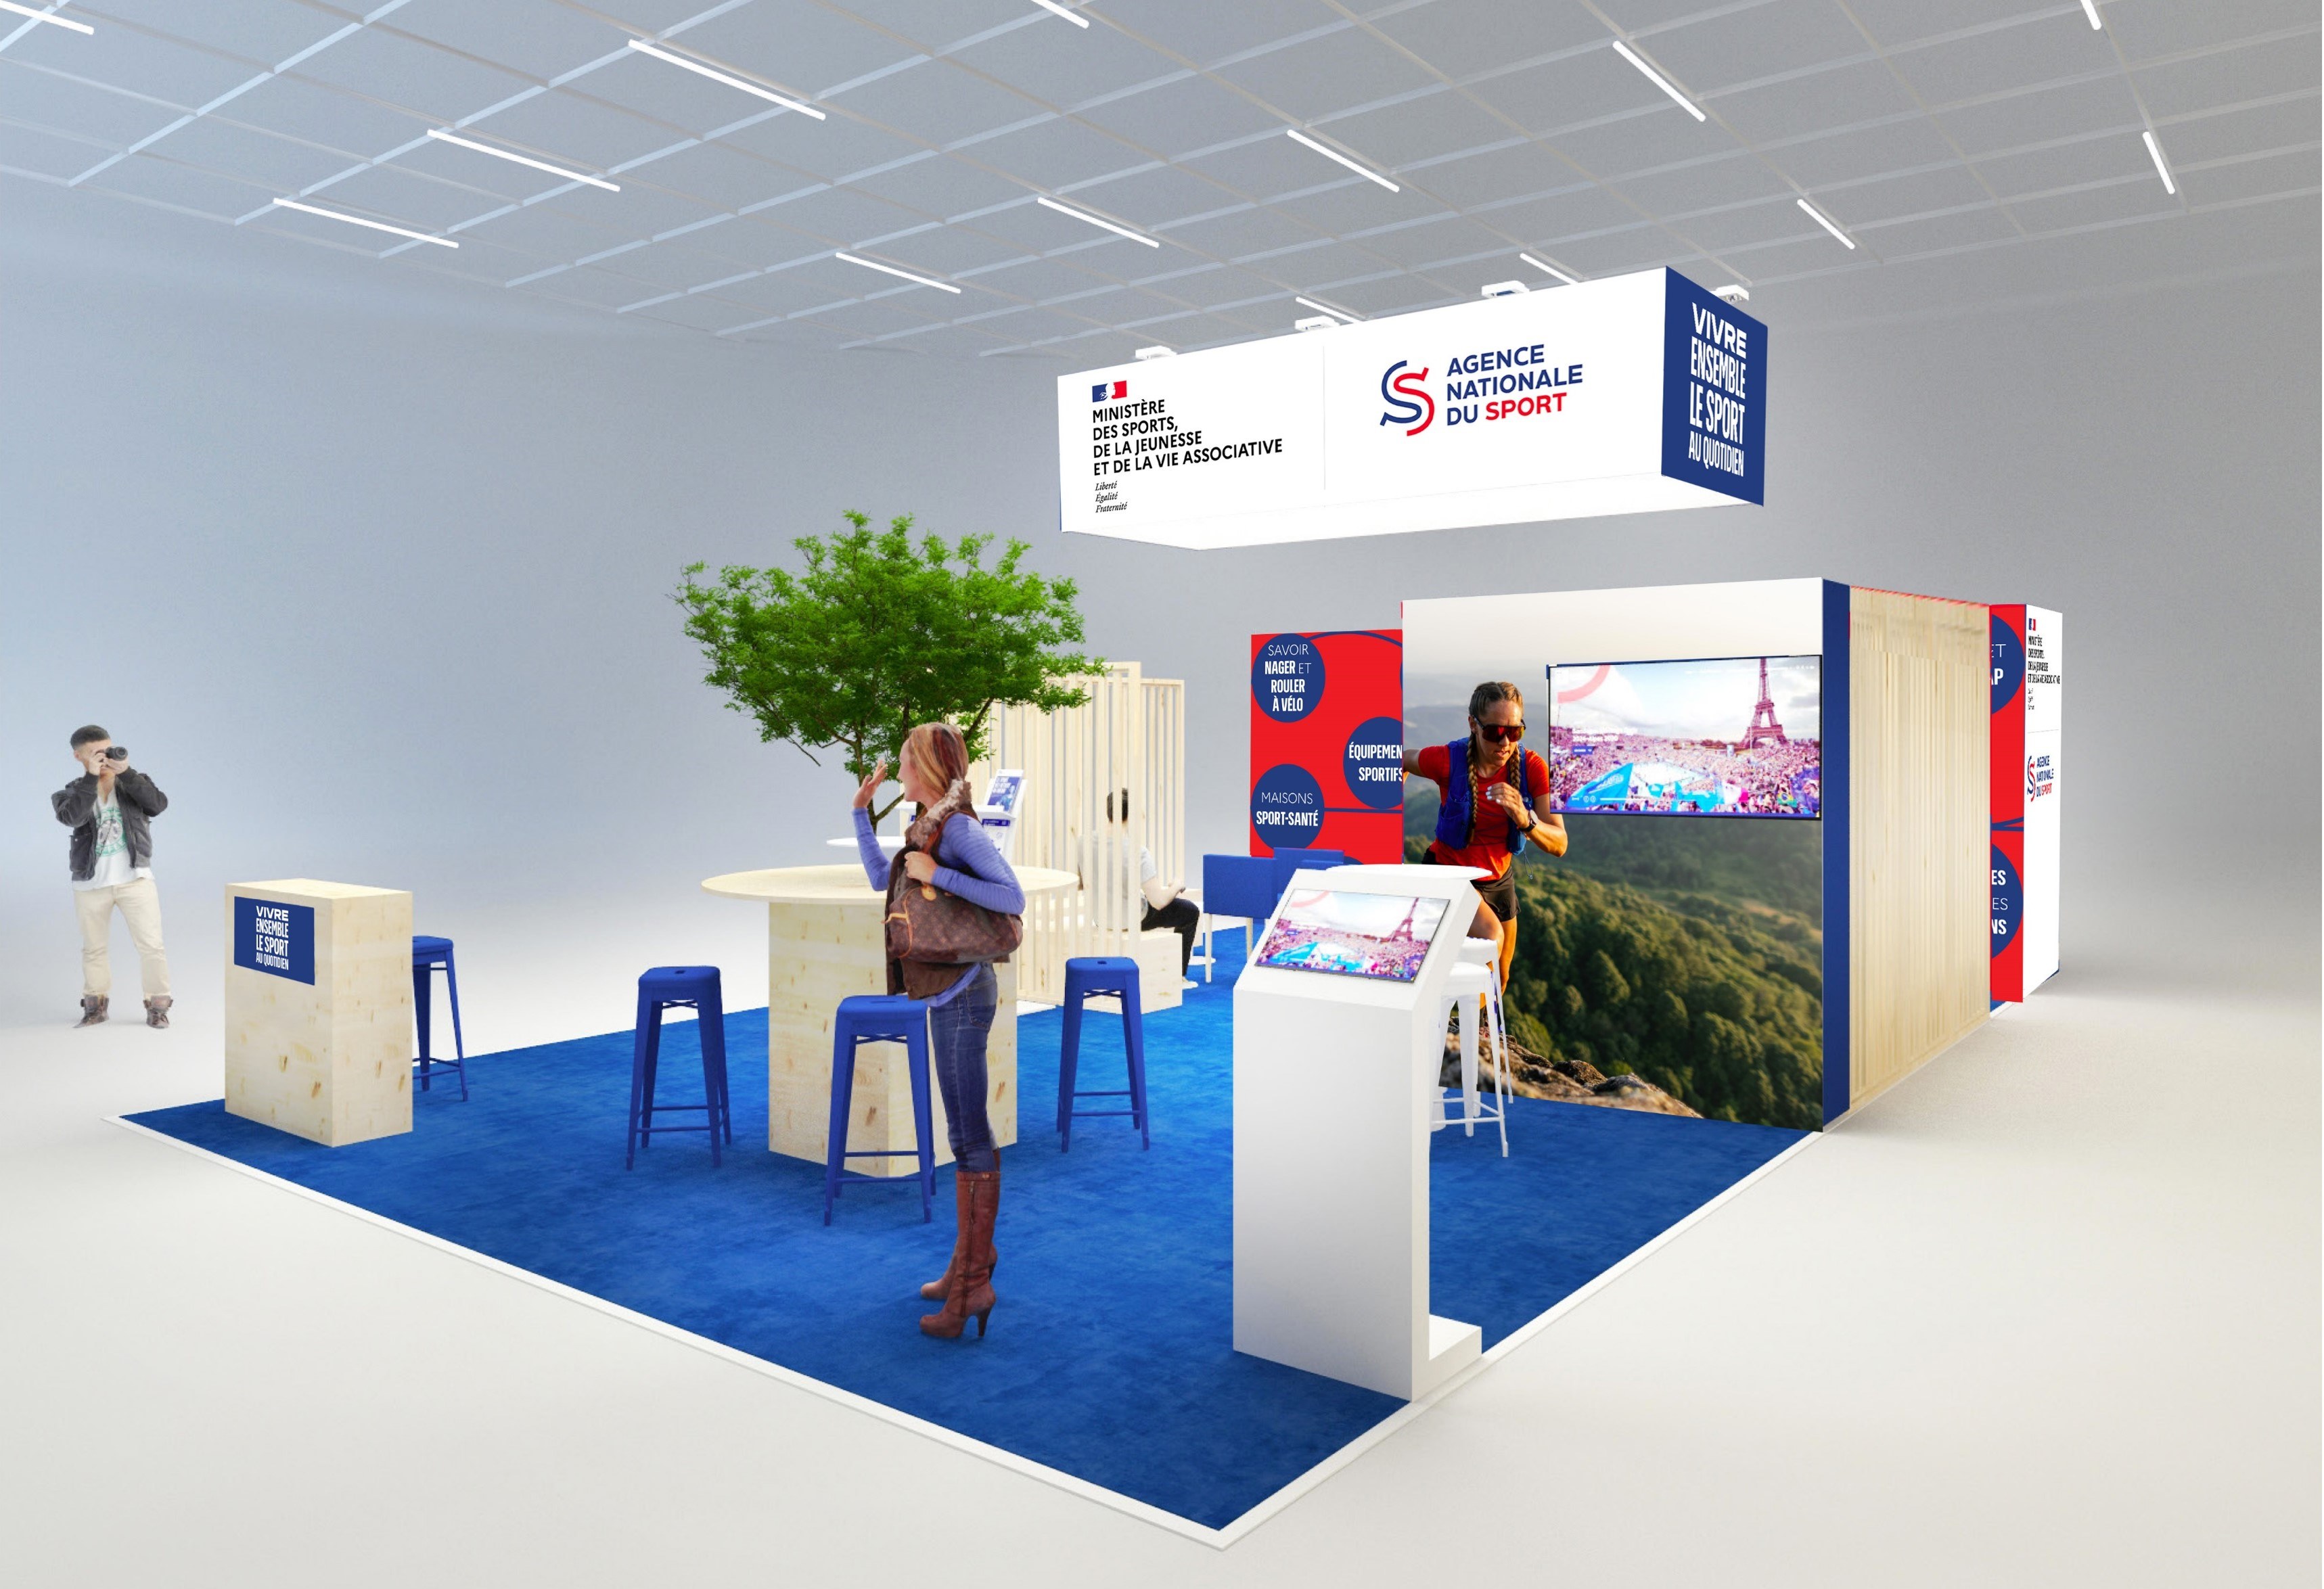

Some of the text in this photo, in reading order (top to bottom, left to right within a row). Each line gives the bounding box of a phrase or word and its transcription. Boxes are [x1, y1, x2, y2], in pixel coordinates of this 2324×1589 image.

[1692, 302, 1746, 359] VIVRE
[1446, 344, 1545, 377] AGENCE
[1691, 336, 1746, 399] ENSEMBLE
[1446, 363, 1583, 401] NATIONALE
[1093, 399, 1165, 423] MINISTÈRE
[1447, 392, 1567, 426] DU SPORT
[1689, 381, 1746, 444] LE SPORT
[1093, 416, 1178, 440] DES SPORTS,
[1093, 430, 1202, 458] DE LA JEUNESSE
[1688, 430, 1744, 477] AU QUOTIDIEN
[1094, 438, 1282, 476] ET DE LA VIE ASSOCIATIVE
[1095, 480, 1117, 491] Liberté
[1095, 491, 1118, 503] Égalité
[1095, 502, 1127, 513] Fraternité
[1268, 643, 1308, 656] SAVOIR
[1264, 660, 1311, 674] NAGER ET
[1271, 678, 1305, 693] ROULER
[1272, 695, 1303, 712] À VÉLO
[1349, 741, 1402, 760] ÉQUIPEMEN
[1359, 766, 1402, 781] SPORTIFS
[1261, 792, 1313, 804] MAISONS
[1256, 810, 1318, 826] SPORT-SANTÉ
[256, 906, 289, 921] VIVRE
[1992, 898, 2008, 910] ES
[256, 918, 289, 938] ENSEMBLE
[256, 934, 289, 957] LE SPORT
[256, 952, 289, 970] AU QUOTIDIEN
